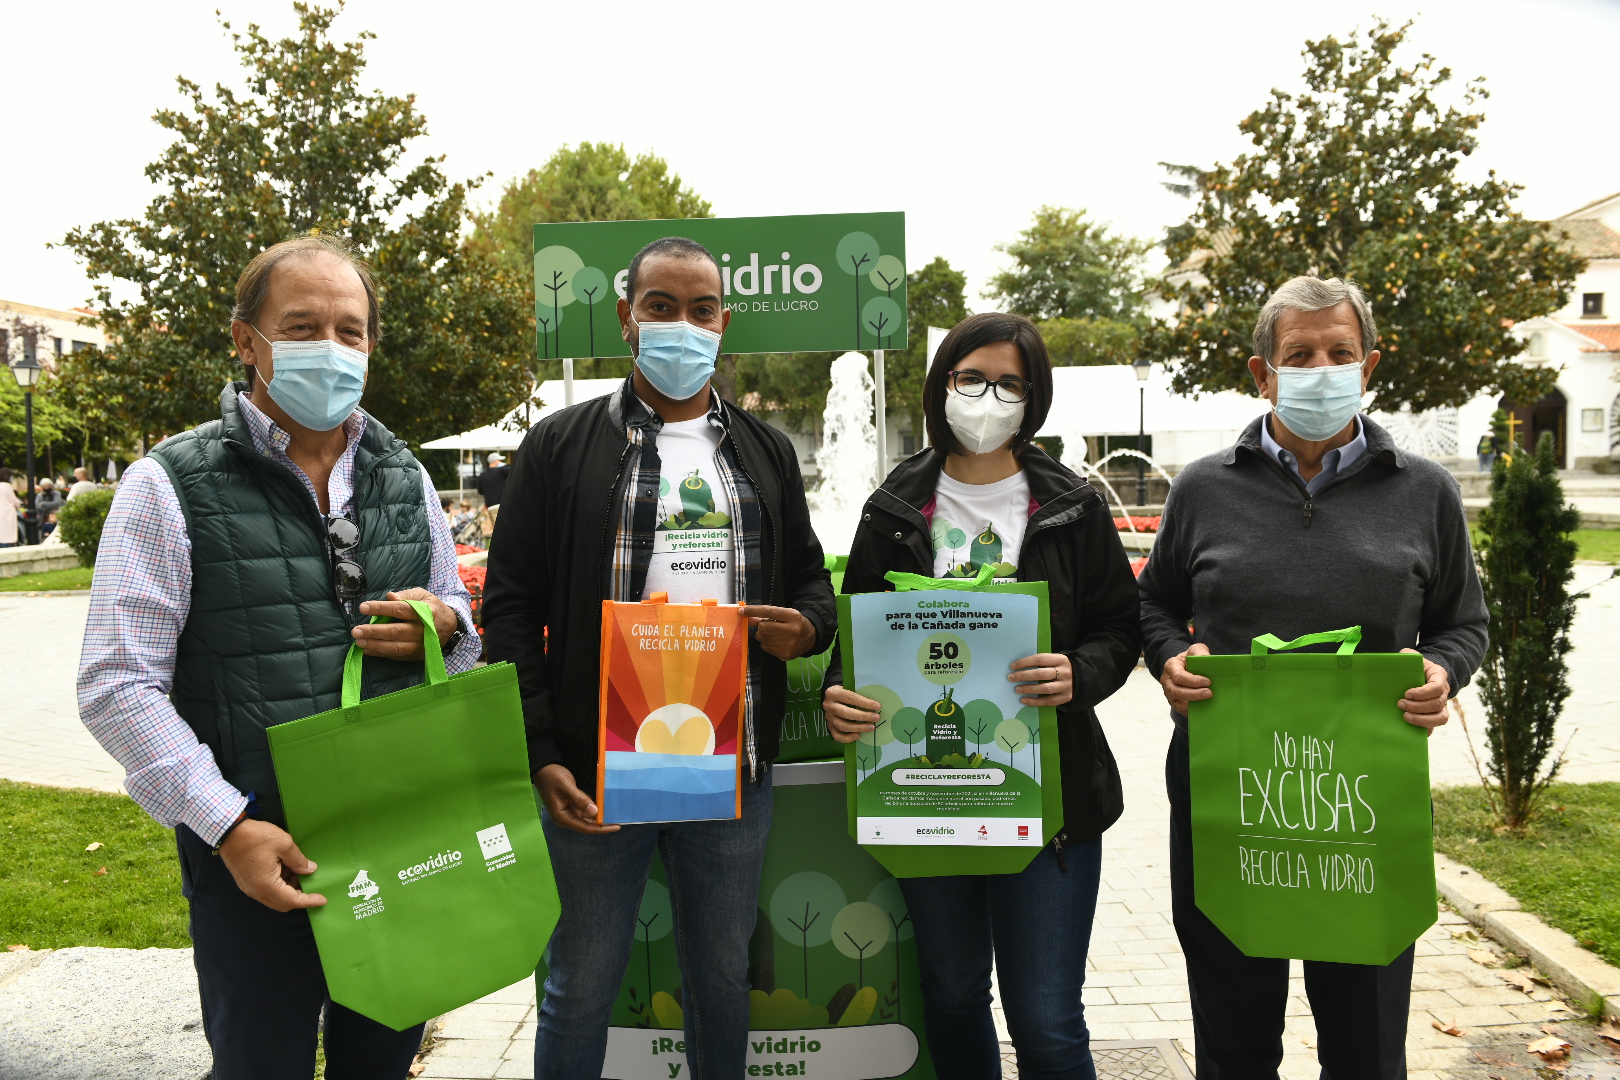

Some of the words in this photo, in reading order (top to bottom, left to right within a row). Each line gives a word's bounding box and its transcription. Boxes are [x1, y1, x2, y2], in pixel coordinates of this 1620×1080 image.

[752, 301, 770, 312] DE
[774, 300, 819, 312] LUCRO
[665, 531, 700, 541] ¡Recicla
[702, 531, 729, 539] vidrio
[679, 541, 723, 549] reforesta!
[671, 557, 727, 571] ecovidrio
[917, 600, 970, 608] Colabora
[885, 612, 911, 621] para
[915, 611, 937, 621] que
[940, 610, 1003, 619] Villanueva
[631, 624, 660, 637] CUIDA
[664, 625, 675, 637] EL
[680, 625, 725, 639] PLANETA
[890, 622, 905, 630] de
[908, 621, 918, 630] la
[922, 620, 966, 630] Cañada
[968, 622, 998, 631] gane
[639, 638, 680, 651] RECICLA
[684, 640, 716, 652] VIDRIO
[928, 641, 959, 660] 50
[1274, 731, 1296, 768] NO
[1302, 735, 1334, 770] HAY
[1238, 767, 1376, 834] EXCUSAS
[916, 826, 955, 835] ecovidrio
[397, 849, 462, 880] ecovidrio
[1239, 845, 1310, 888] RECICLA
[1318, 853, 1375, 894] VIDRIO
[350, 880, 373, 893] FMM
[355, 905, 385, 921] MADRID
[751, 1036, 822, 1054] vidrio
[667, 1062, 682, 1079] y
